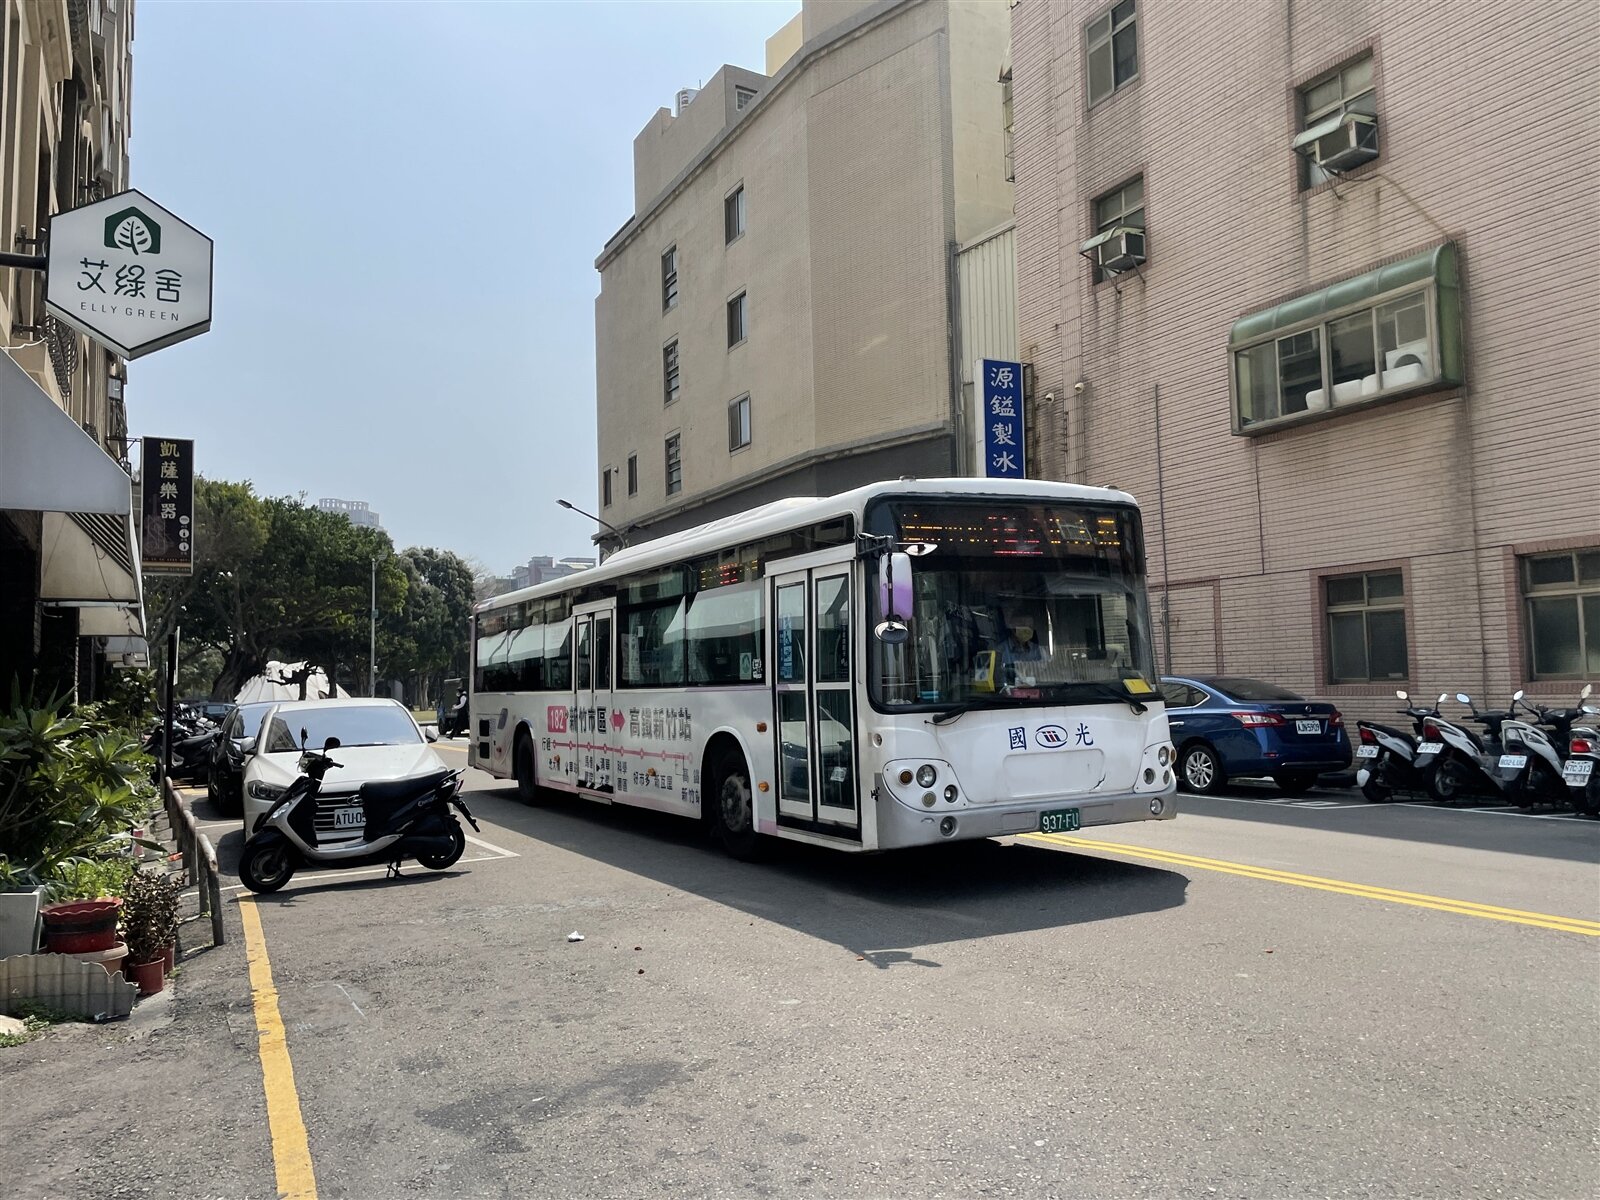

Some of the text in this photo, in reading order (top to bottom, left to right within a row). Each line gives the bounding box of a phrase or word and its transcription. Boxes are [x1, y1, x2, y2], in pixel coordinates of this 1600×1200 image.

[80, 302, 179, 321] ELLY GREEN
[990, 367, 1018, 472] 源鎰製冰
[159, 440, 180, 519] 凱薩樂器
[550, 709, 564, 730] 182
[1042, 812, 1079, 831] 937-FU
